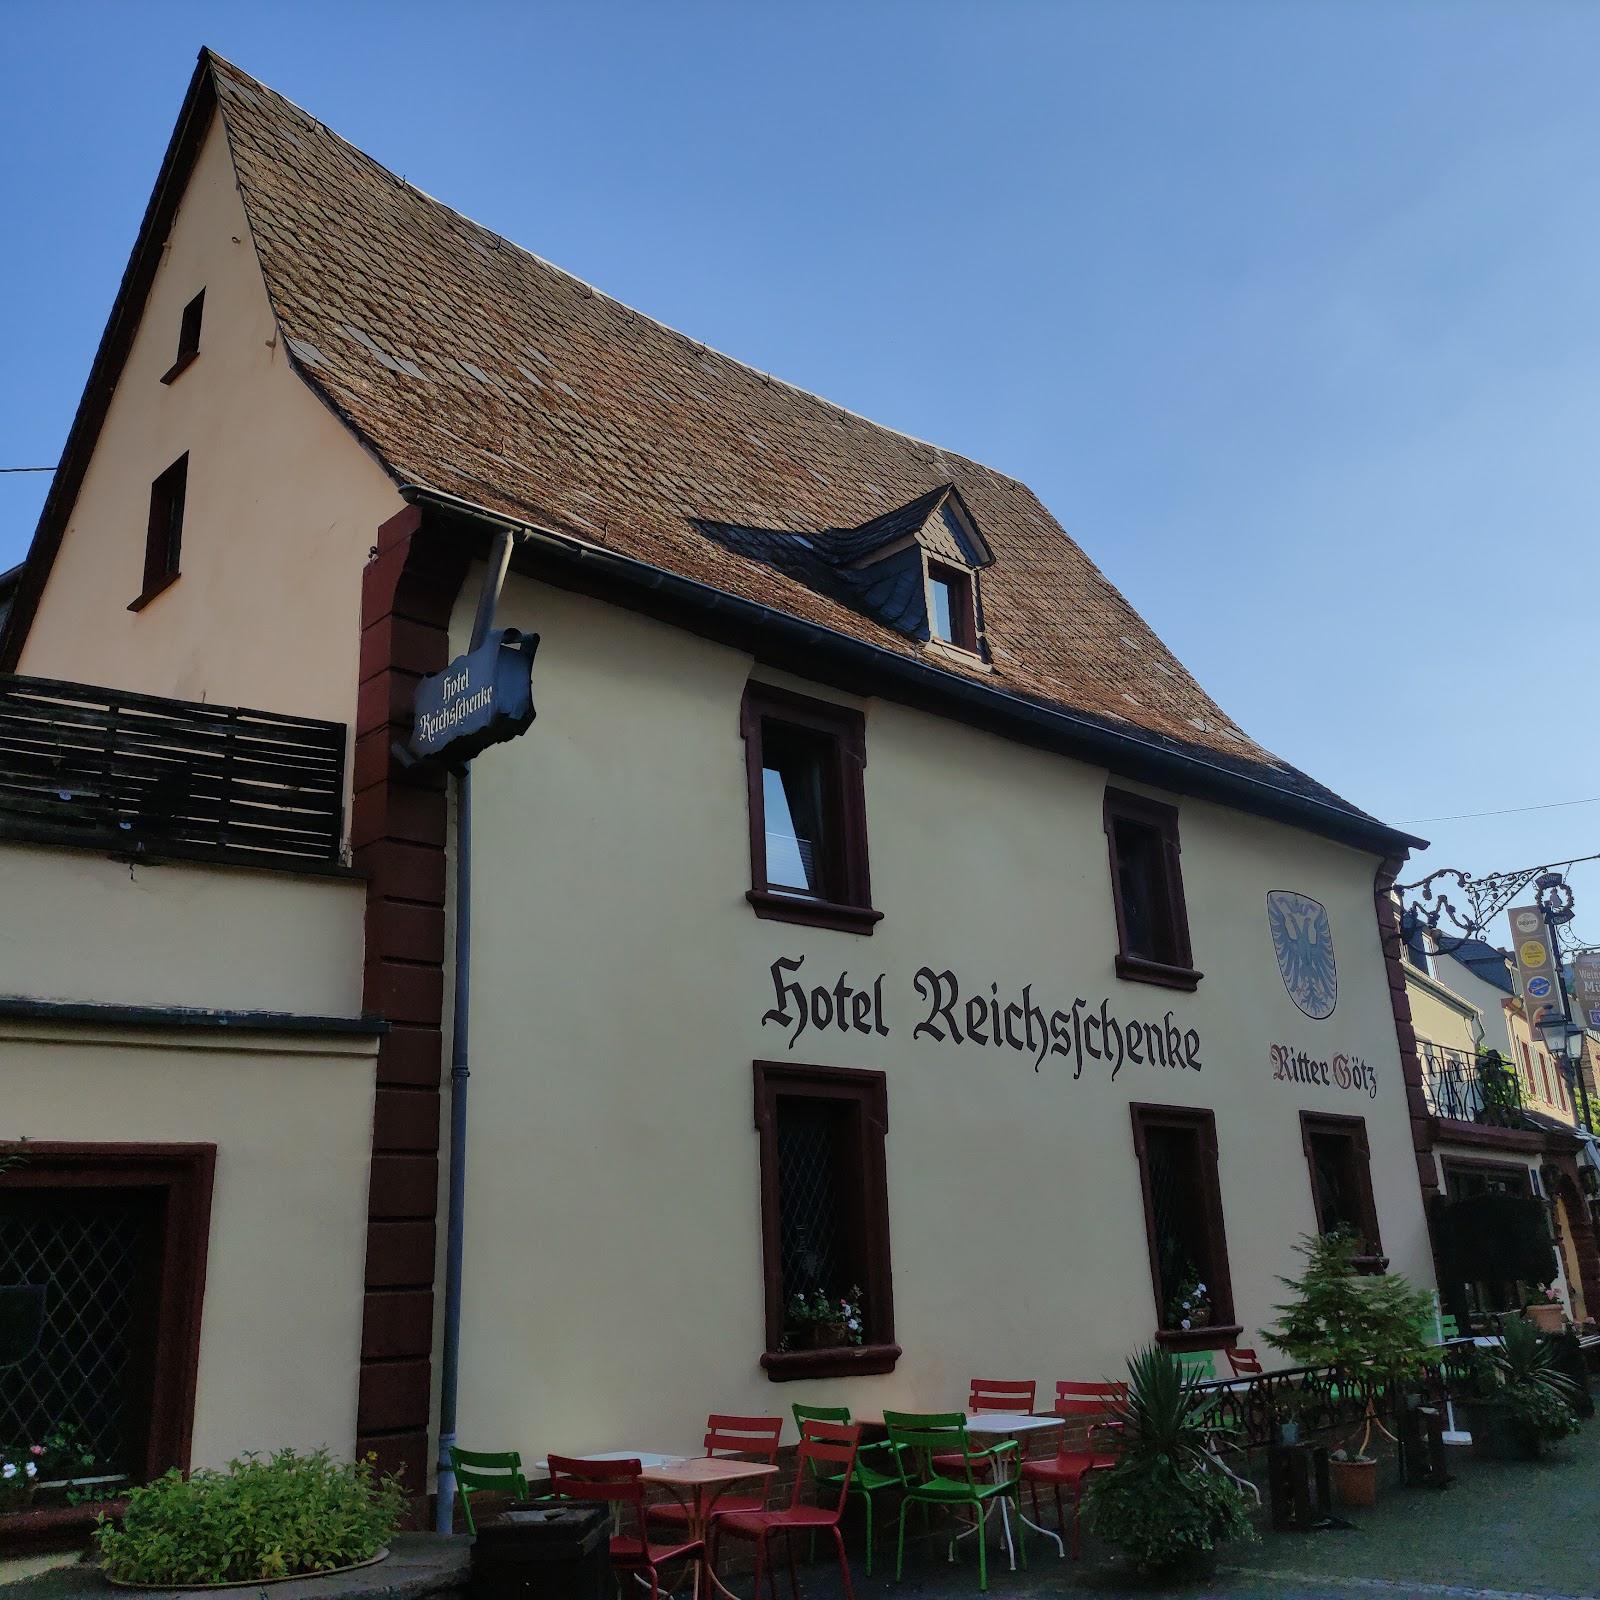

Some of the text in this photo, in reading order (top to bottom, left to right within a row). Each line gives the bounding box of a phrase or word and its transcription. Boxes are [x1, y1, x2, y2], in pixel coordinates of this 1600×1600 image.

[442, 667, 469, 704] Hotel
[762, 955, 889, 1050] Hotel
[1269, 1043, 1377, 1099] Ritter Götz
